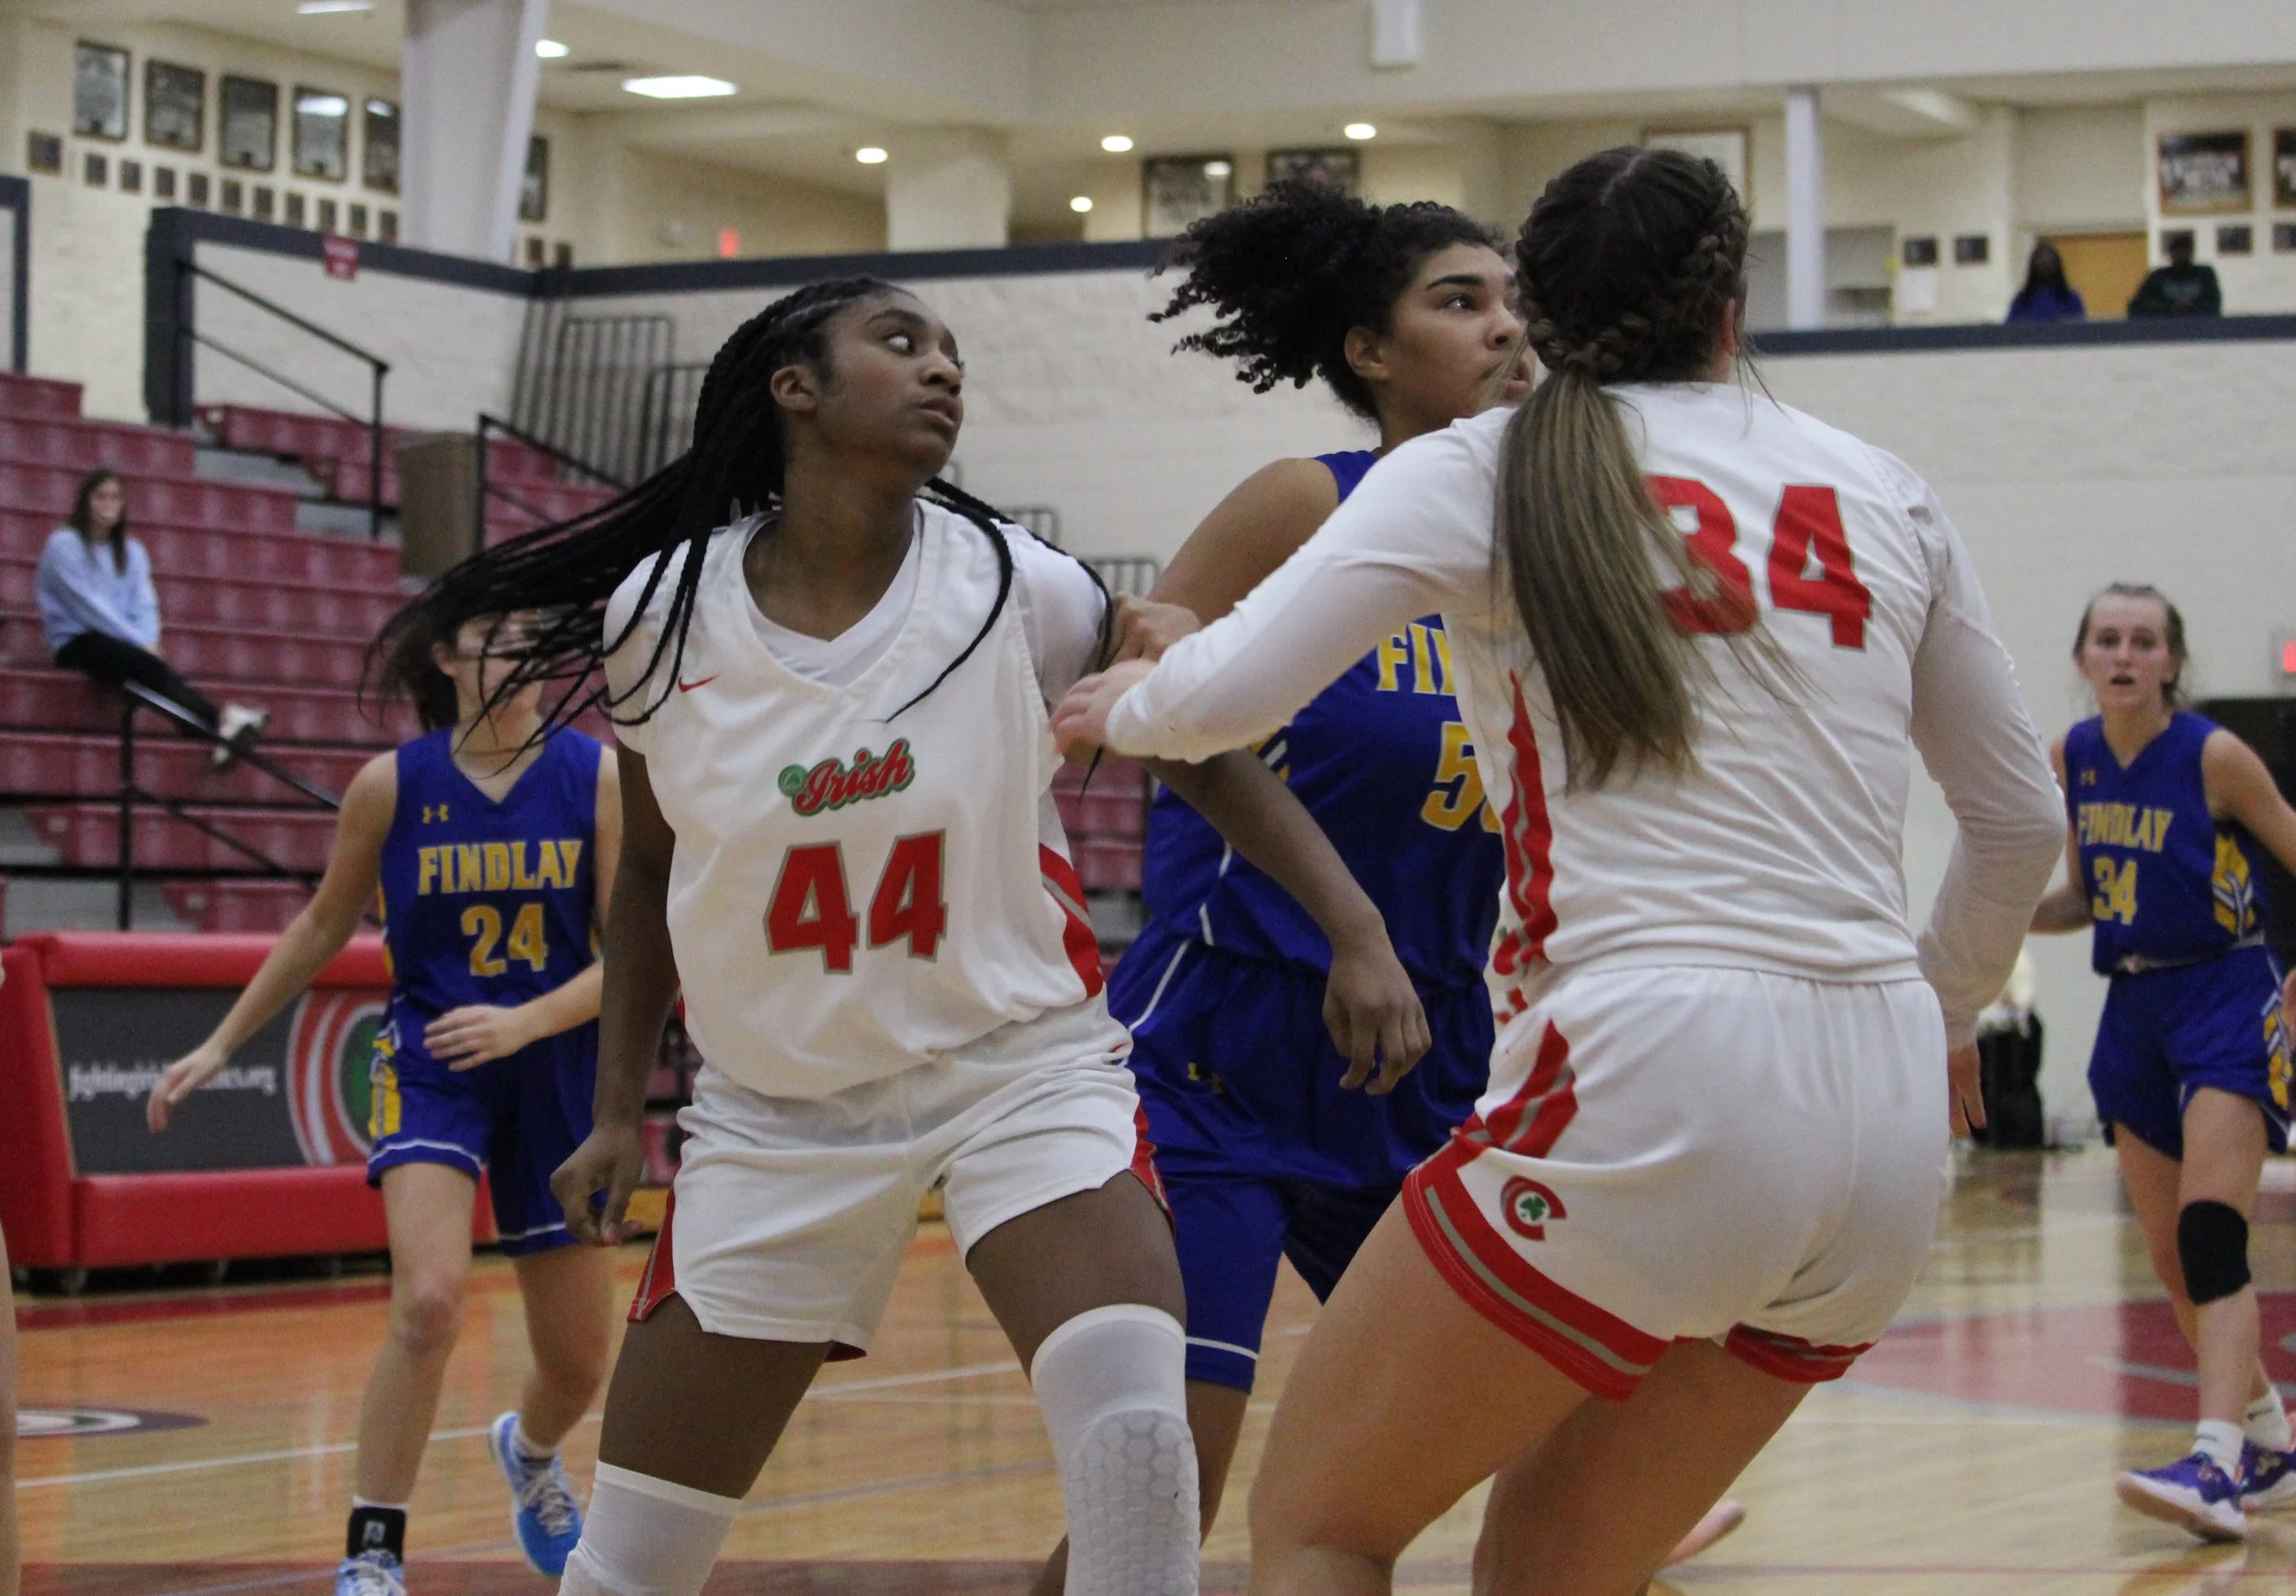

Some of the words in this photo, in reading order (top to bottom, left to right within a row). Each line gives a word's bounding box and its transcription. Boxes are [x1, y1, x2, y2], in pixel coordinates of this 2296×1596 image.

[1639, 473, 1873, 654] 34
[792, 737, 915, 816] Irish
[1420, 721, 1504, 834] 5
[2077, 802, 2174, 853] FINDLAY
[417, 838, 583, 895] FINDLAY
[762, 828, 949, 974] 44
[2093, 856, 2138, 926] 34
[461, 904, 548, 977] 24
